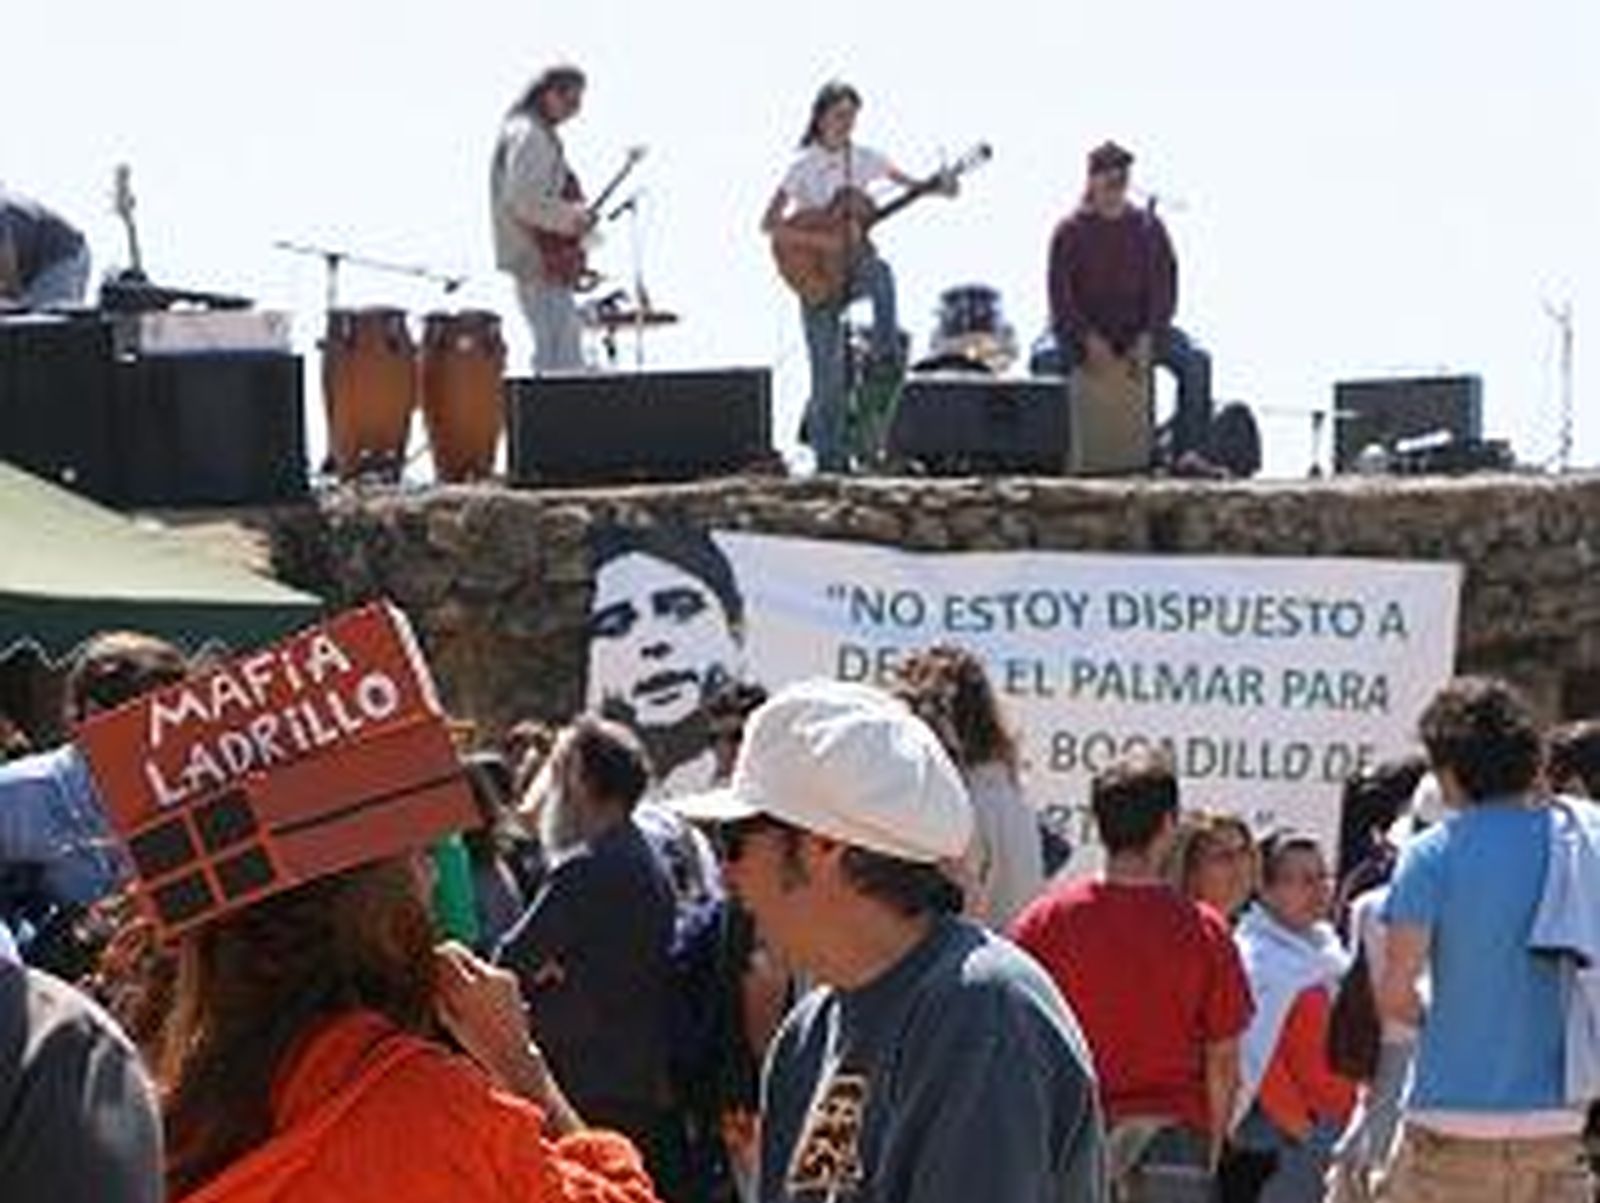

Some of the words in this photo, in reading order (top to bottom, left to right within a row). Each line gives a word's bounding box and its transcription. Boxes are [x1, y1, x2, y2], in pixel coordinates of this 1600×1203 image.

[944, 590, 1089, 632] ESTOY
[1106, 592, 1366, 638] DISPUESTO
[1378, 602, 1406, 637] A
[1005, 658, 1054, 696] EL
[1070, 660, 1264, 706] PALMAR
[1281, 670, 1390, 712] PARA
